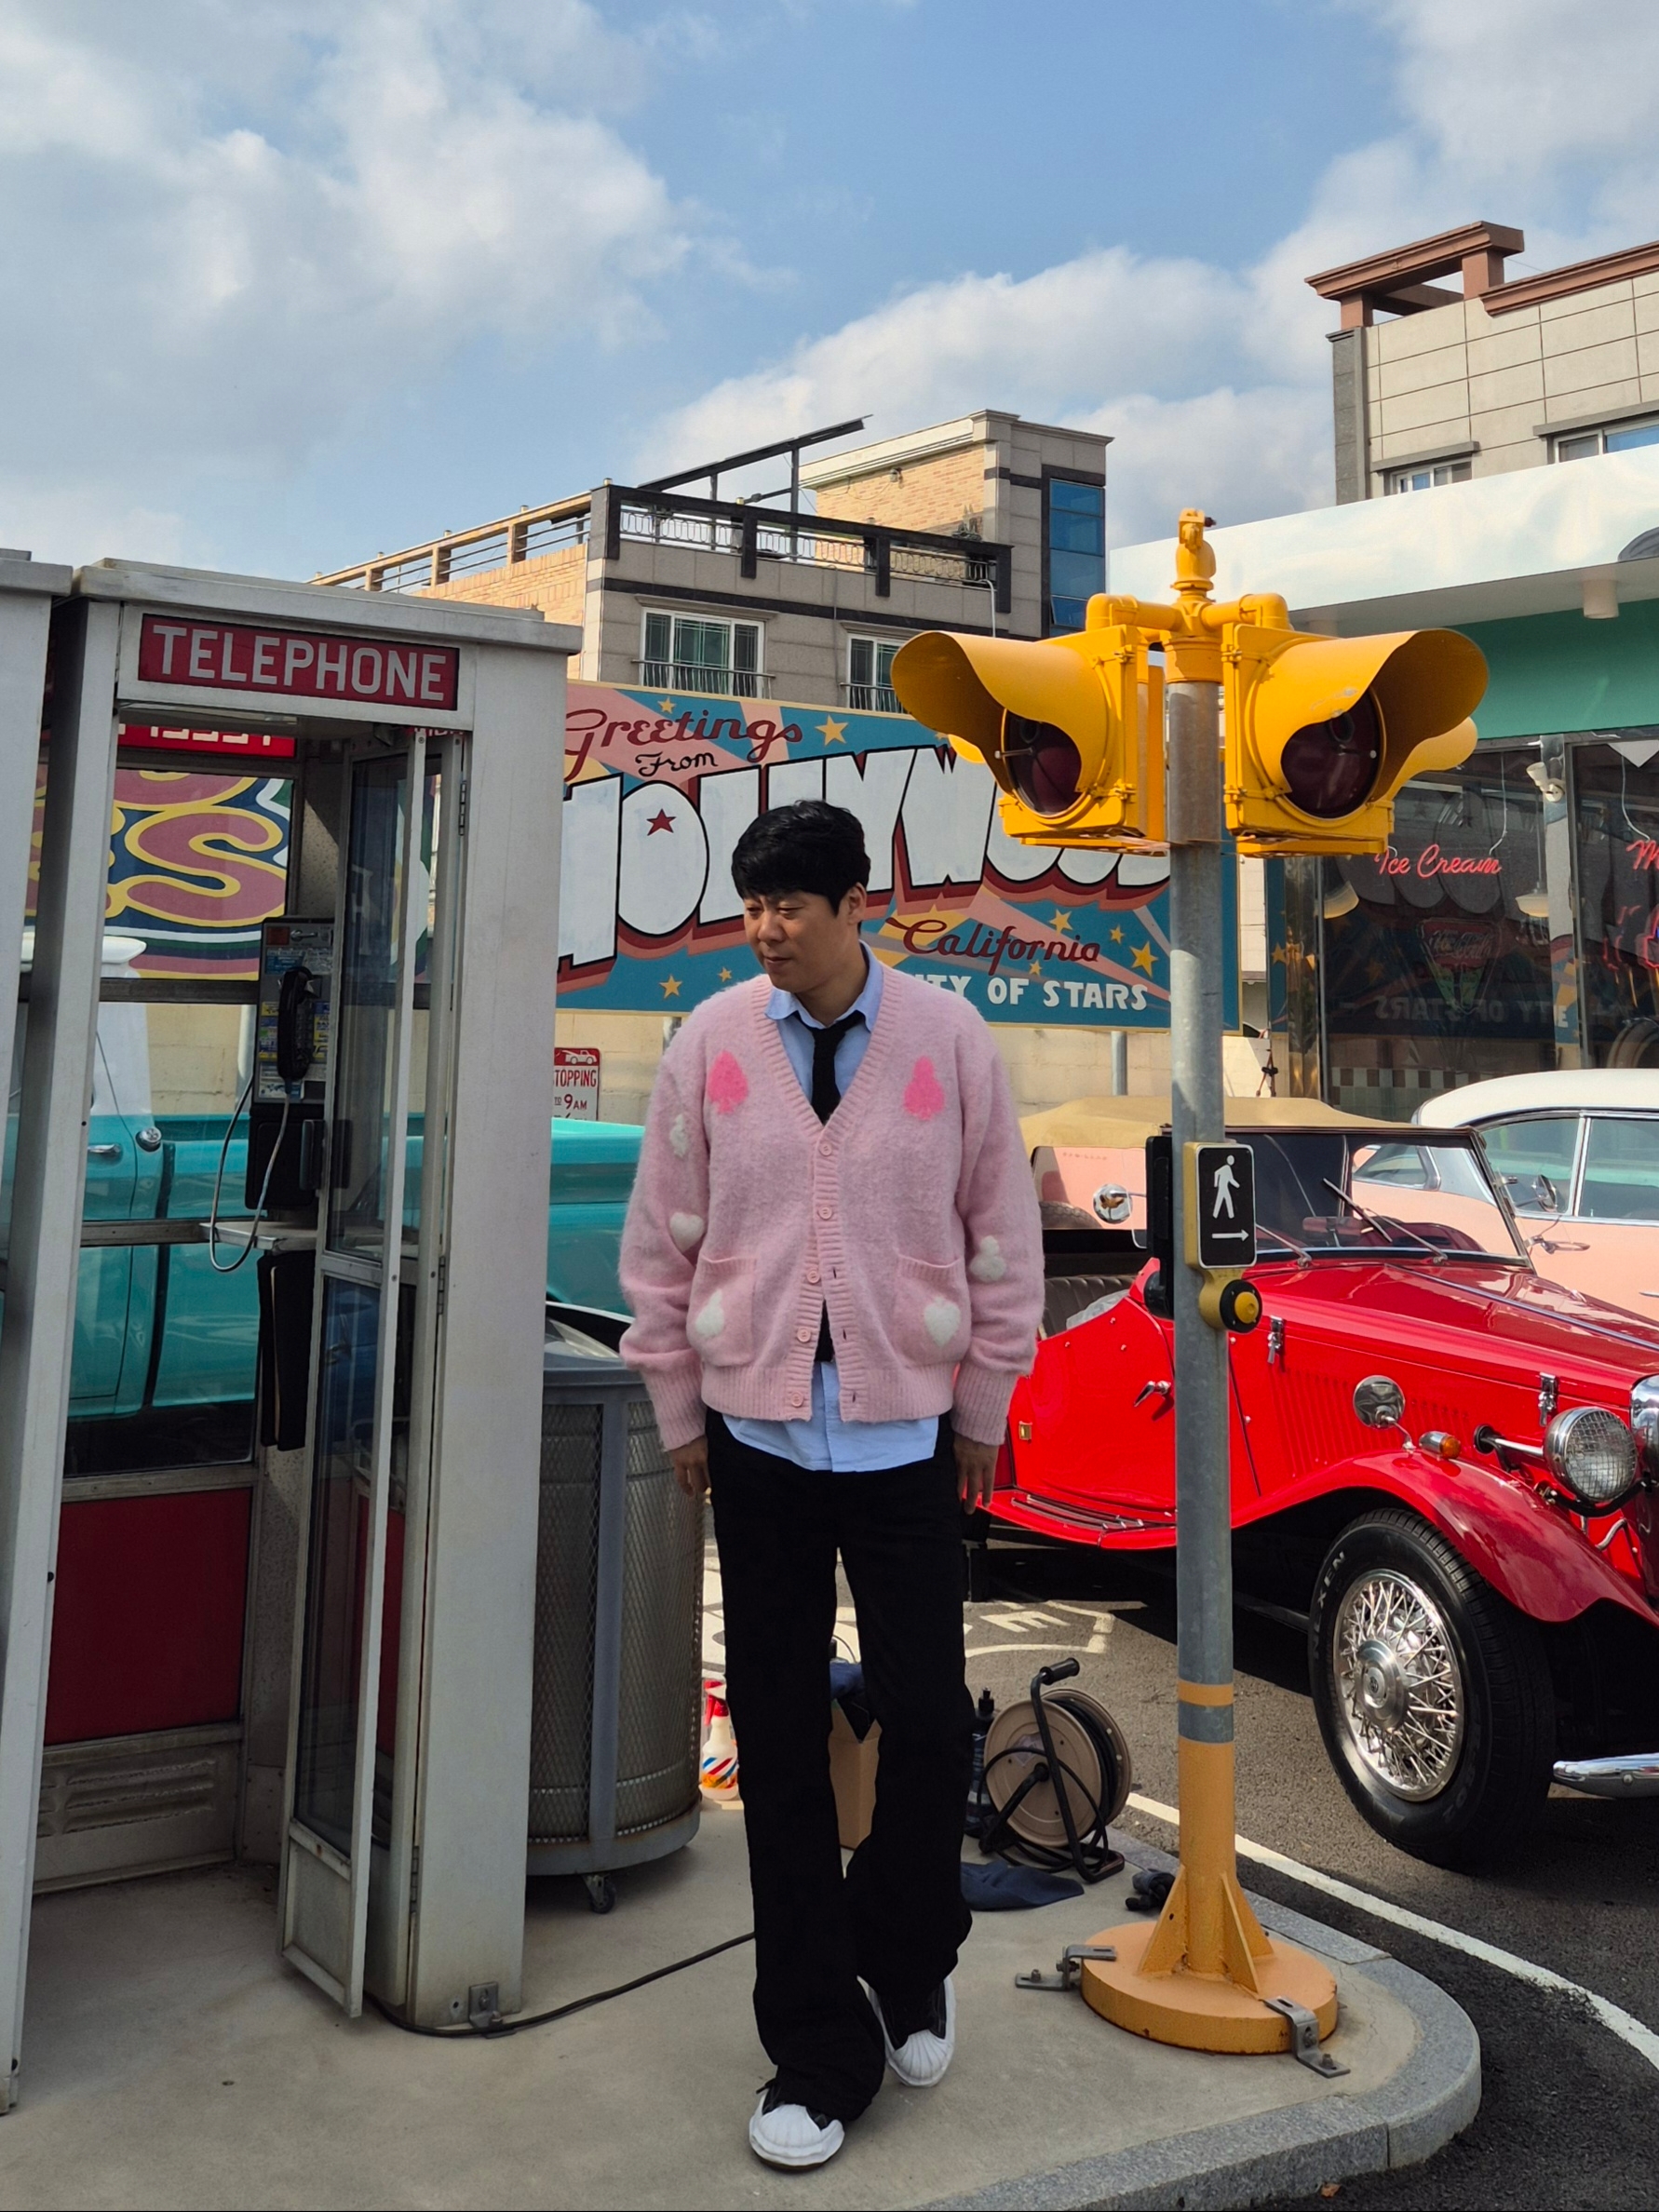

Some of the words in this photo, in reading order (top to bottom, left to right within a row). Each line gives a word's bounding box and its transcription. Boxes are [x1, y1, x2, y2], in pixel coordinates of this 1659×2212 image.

[153, 625, 446, 701] TELEPHONE
[564, 708, 803, 782] Greetings
[635, 751, 719, 777] From
[1373, 848, 1411, 875] Ice
[1416, 843, 1503, 879] Cream
[885, 916, 1102, 976] California
[987, 978, 1029, 1005] OF
[1043, 980, 1148, 1011] STARS
[554, 1069, 597, 1087] TOPPING
